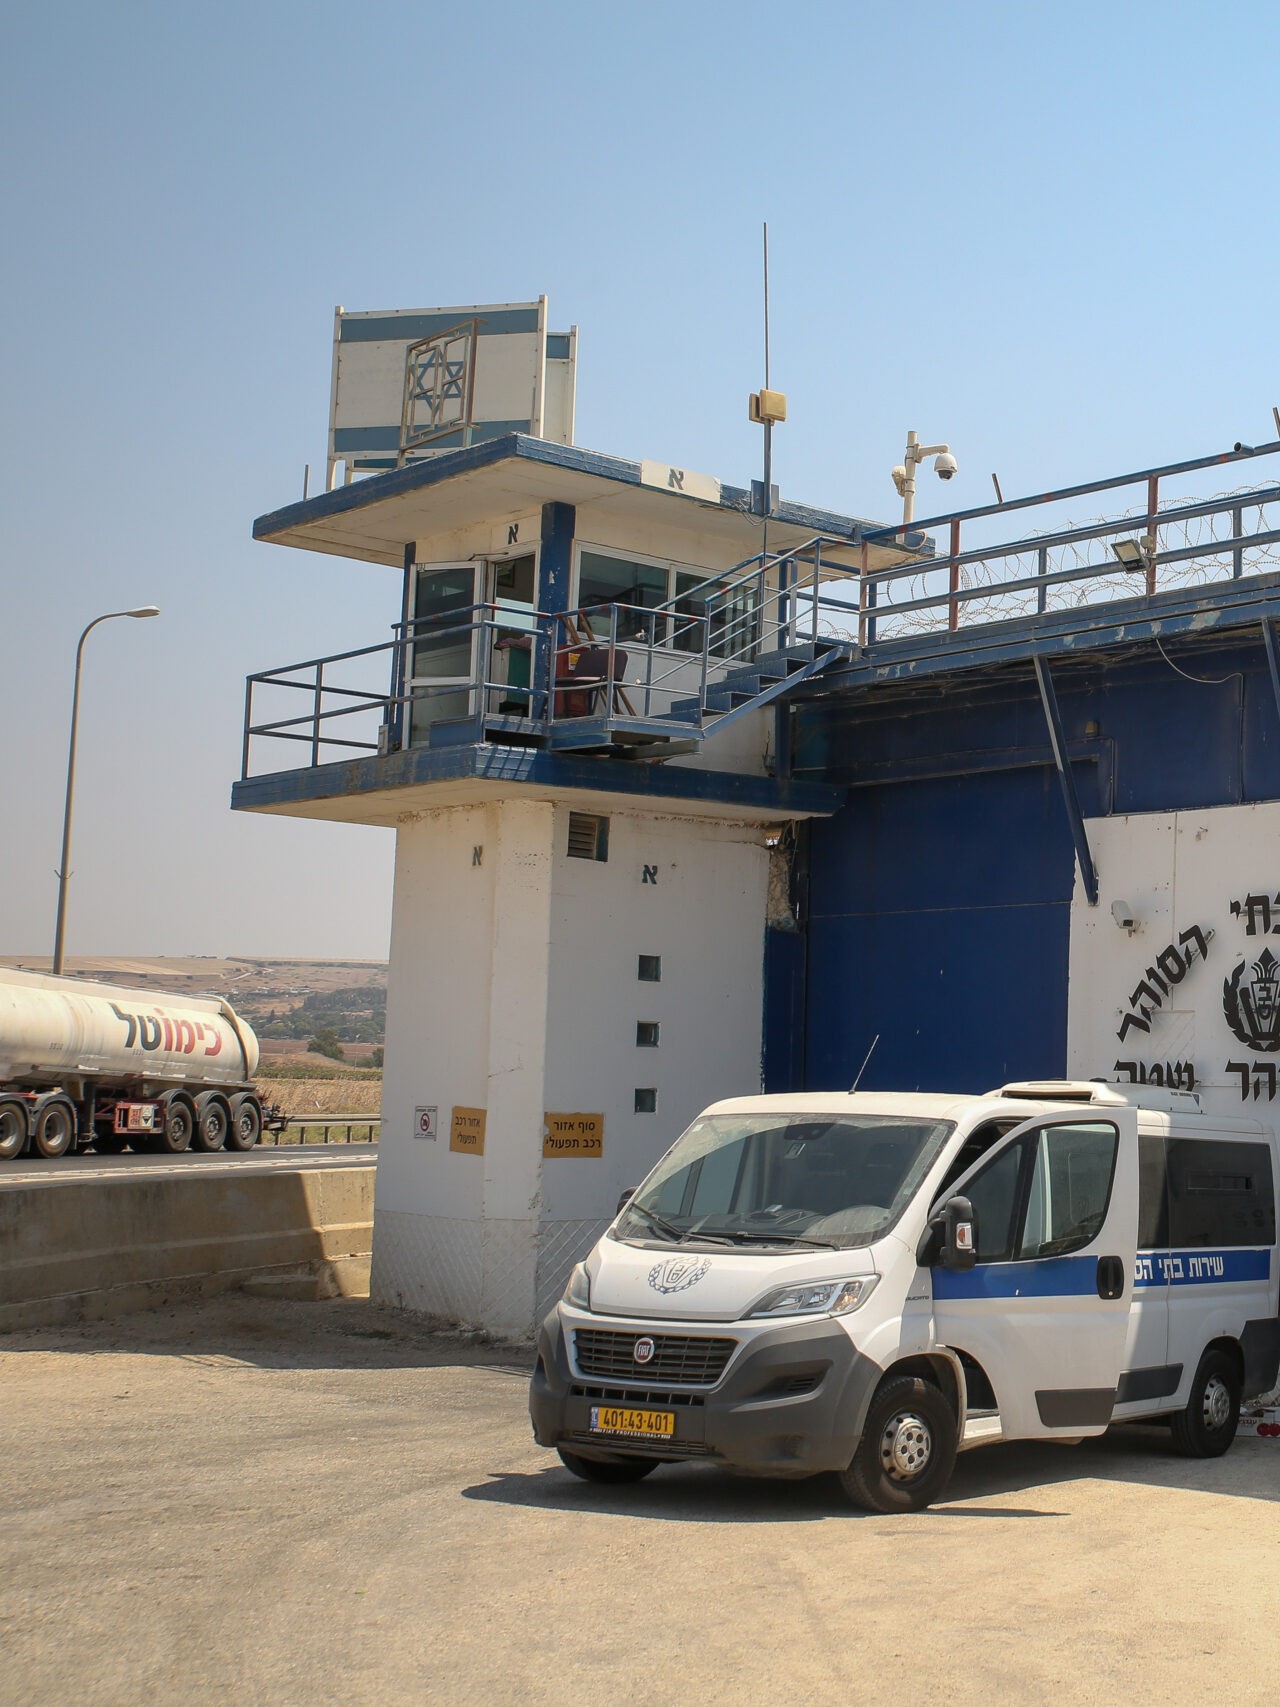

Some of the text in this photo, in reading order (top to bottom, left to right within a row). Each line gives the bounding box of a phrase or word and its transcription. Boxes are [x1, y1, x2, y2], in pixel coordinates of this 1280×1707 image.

[668, 468, 685, 490] א
[507, 523, 519, 545] א
[472, 846, 483, 867] א
[641, 864, 658, 885] א
[1116, 924, 1209, 1043] הסוהר
[109, 1003, 222, 1056] כימוטל
[455, 1116, 467, 1126] רכב
[553, 1121, 595, 1133] סוף אזור
[545, 1136, 601, 1149] רכב תפעולי
[1158, 1258, 1185, 1279] בתי
[1189, 1256, 1224, 1278] שירות
